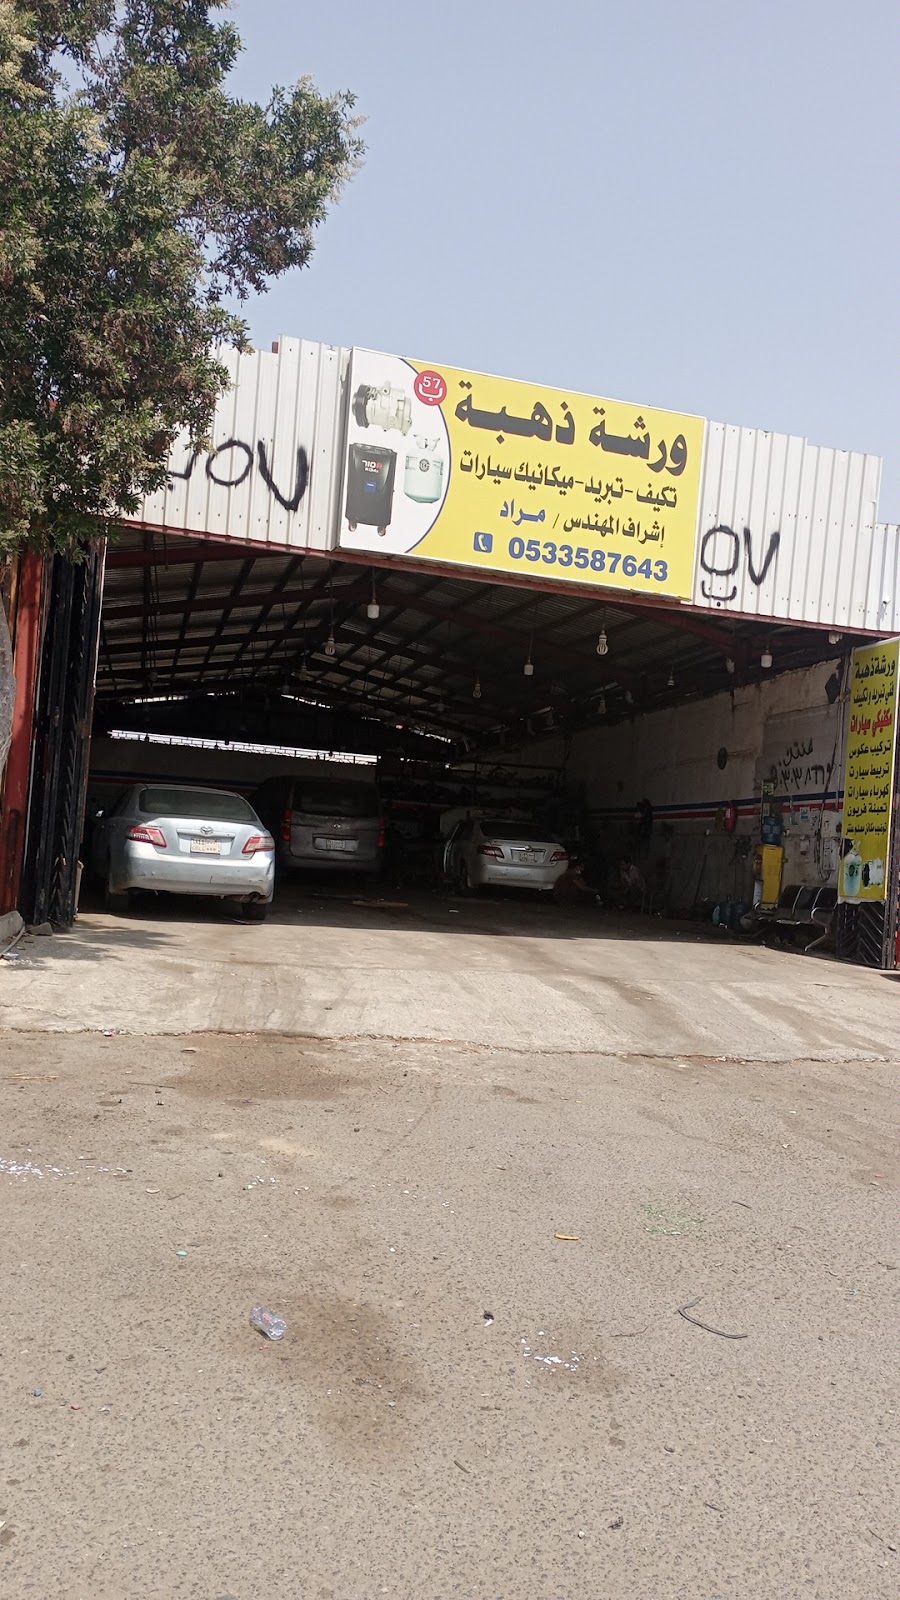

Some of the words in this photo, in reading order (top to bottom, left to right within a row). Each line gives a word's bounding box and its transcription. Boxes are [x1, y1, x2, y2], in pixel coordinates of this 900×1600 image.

[418, 382, 443, 402] ب
[422, 375, 441, 389] 57
[454, 380, 575, 445] ذهبة
[589, 406, 687, 477] ورشة
[460, 449, 512, 485] سيارات
[500, 498, 546, 526] مراد
[563, 512, 619, 537] المهندس
[622, 516, 665, 548] إشراف
[508, 536, 668, 582] 0533587643
[855, 656, 875, 683] ذهبة
[874, 654, 896, 677] ورشة
[850, 714, 871, 736] سيارات
[849, 743, 870, 759] عكوس
[870, 739, 892, 756] تركيب
[848, 785, 868, 800] سيارات
[869, 783, 889, 800] كهرباء
[847, 803, 867, 817] فريون
